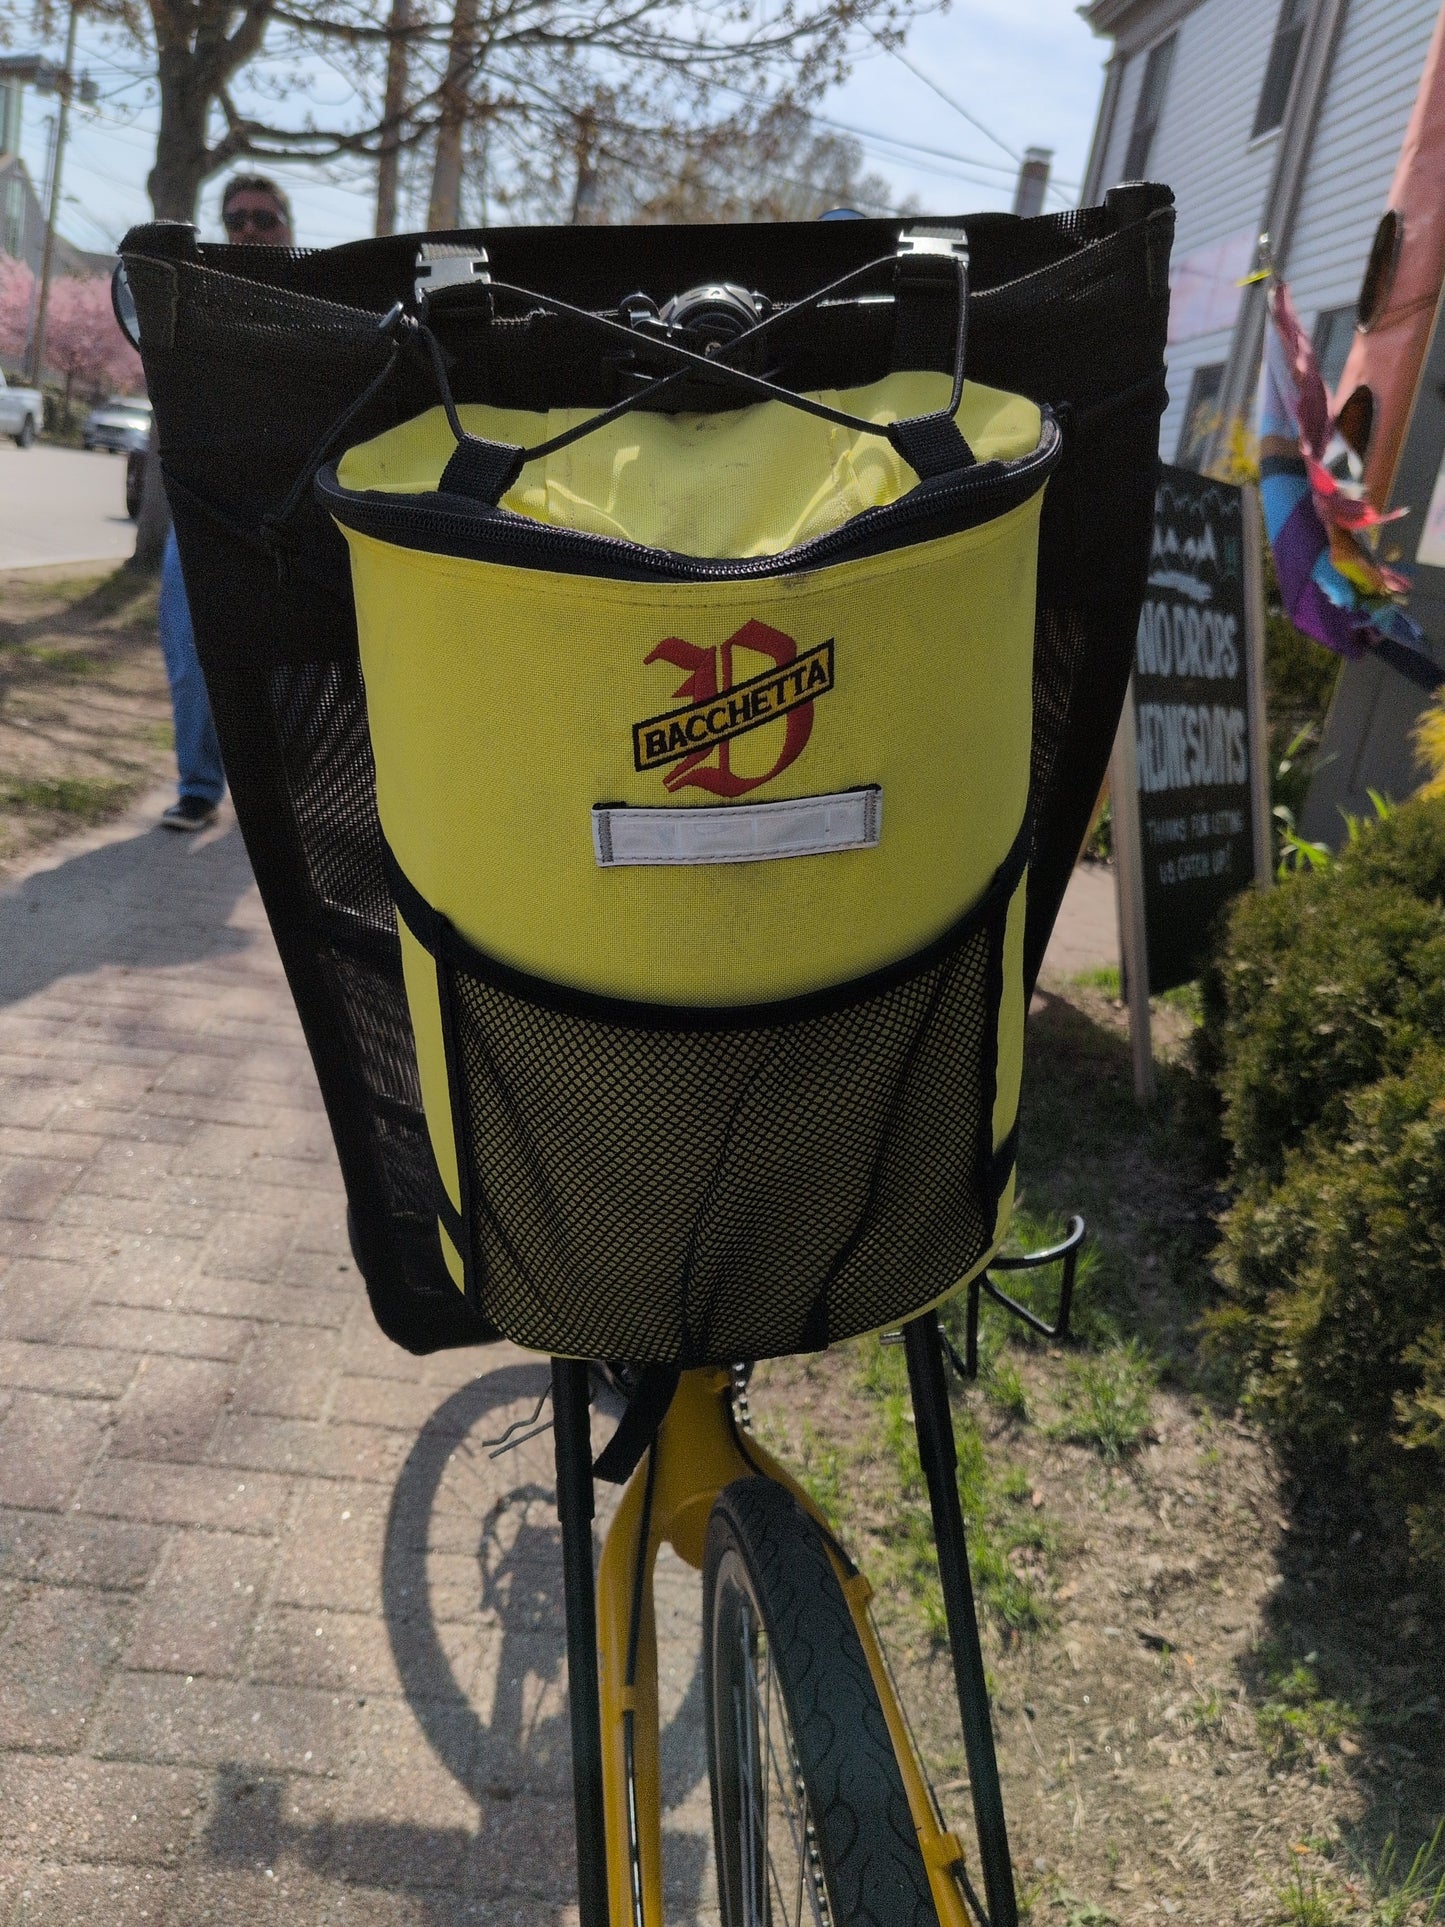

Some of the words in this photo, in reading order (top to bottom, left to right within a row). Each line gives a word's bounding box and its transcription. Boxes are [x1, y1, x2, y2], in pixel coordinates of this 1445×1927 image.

[1136, 601, 1172, 678] NO
[1172, 605, 1239, 680] DROPS
[644, 658, 828, 759] BACCHETTA
